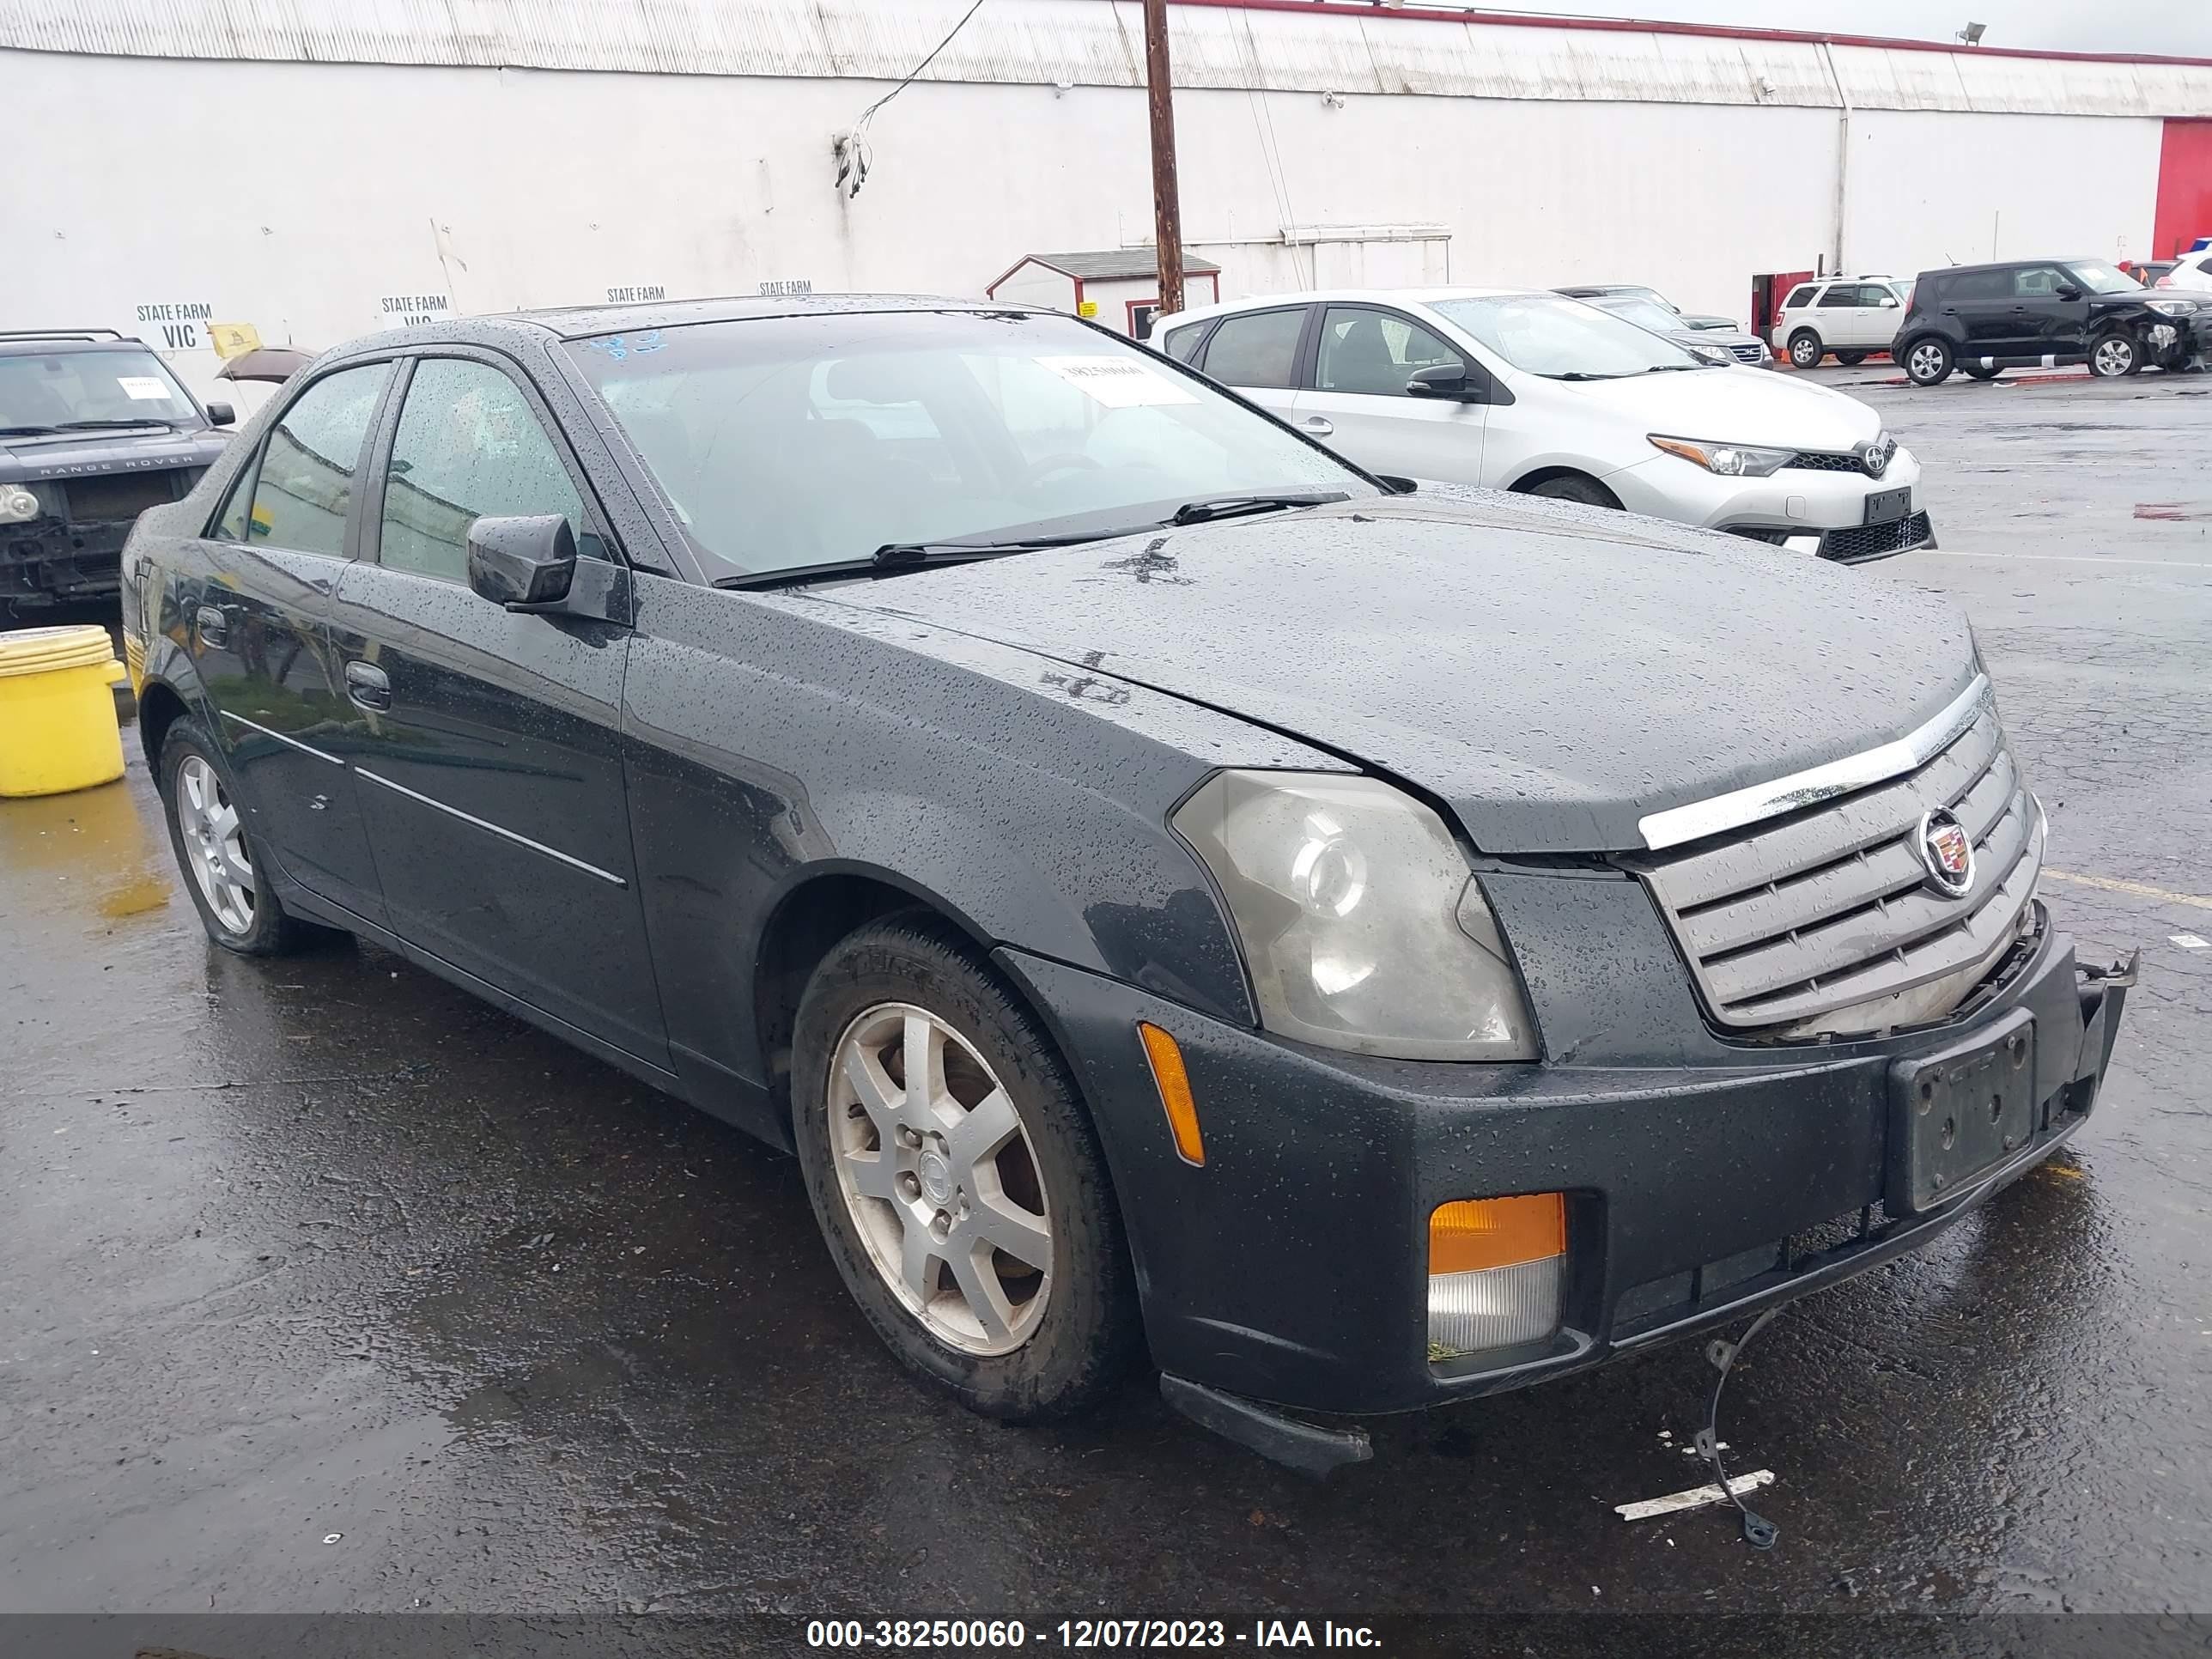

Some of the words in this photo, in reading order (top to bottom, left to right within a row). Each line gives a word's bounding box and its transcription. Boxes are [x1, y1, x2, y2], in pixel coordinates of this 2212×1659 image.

[607, 288, 635, 303] STATE
[637, 286, 665, 301] FARM
[760, 282, 786, 296] STATE
[786, 280, 812, 295] FARM
[137, 305, 173, 321] STATE
[175, 303, 213, 320] FARM
[382, 297, 414, 313] STATE
[415, 295, 448, 311] FARM
[162, 324, 197, 349] VIC
[40, 464, 112, 475] RANGE
[125, 456, 194, 468] ROVER
